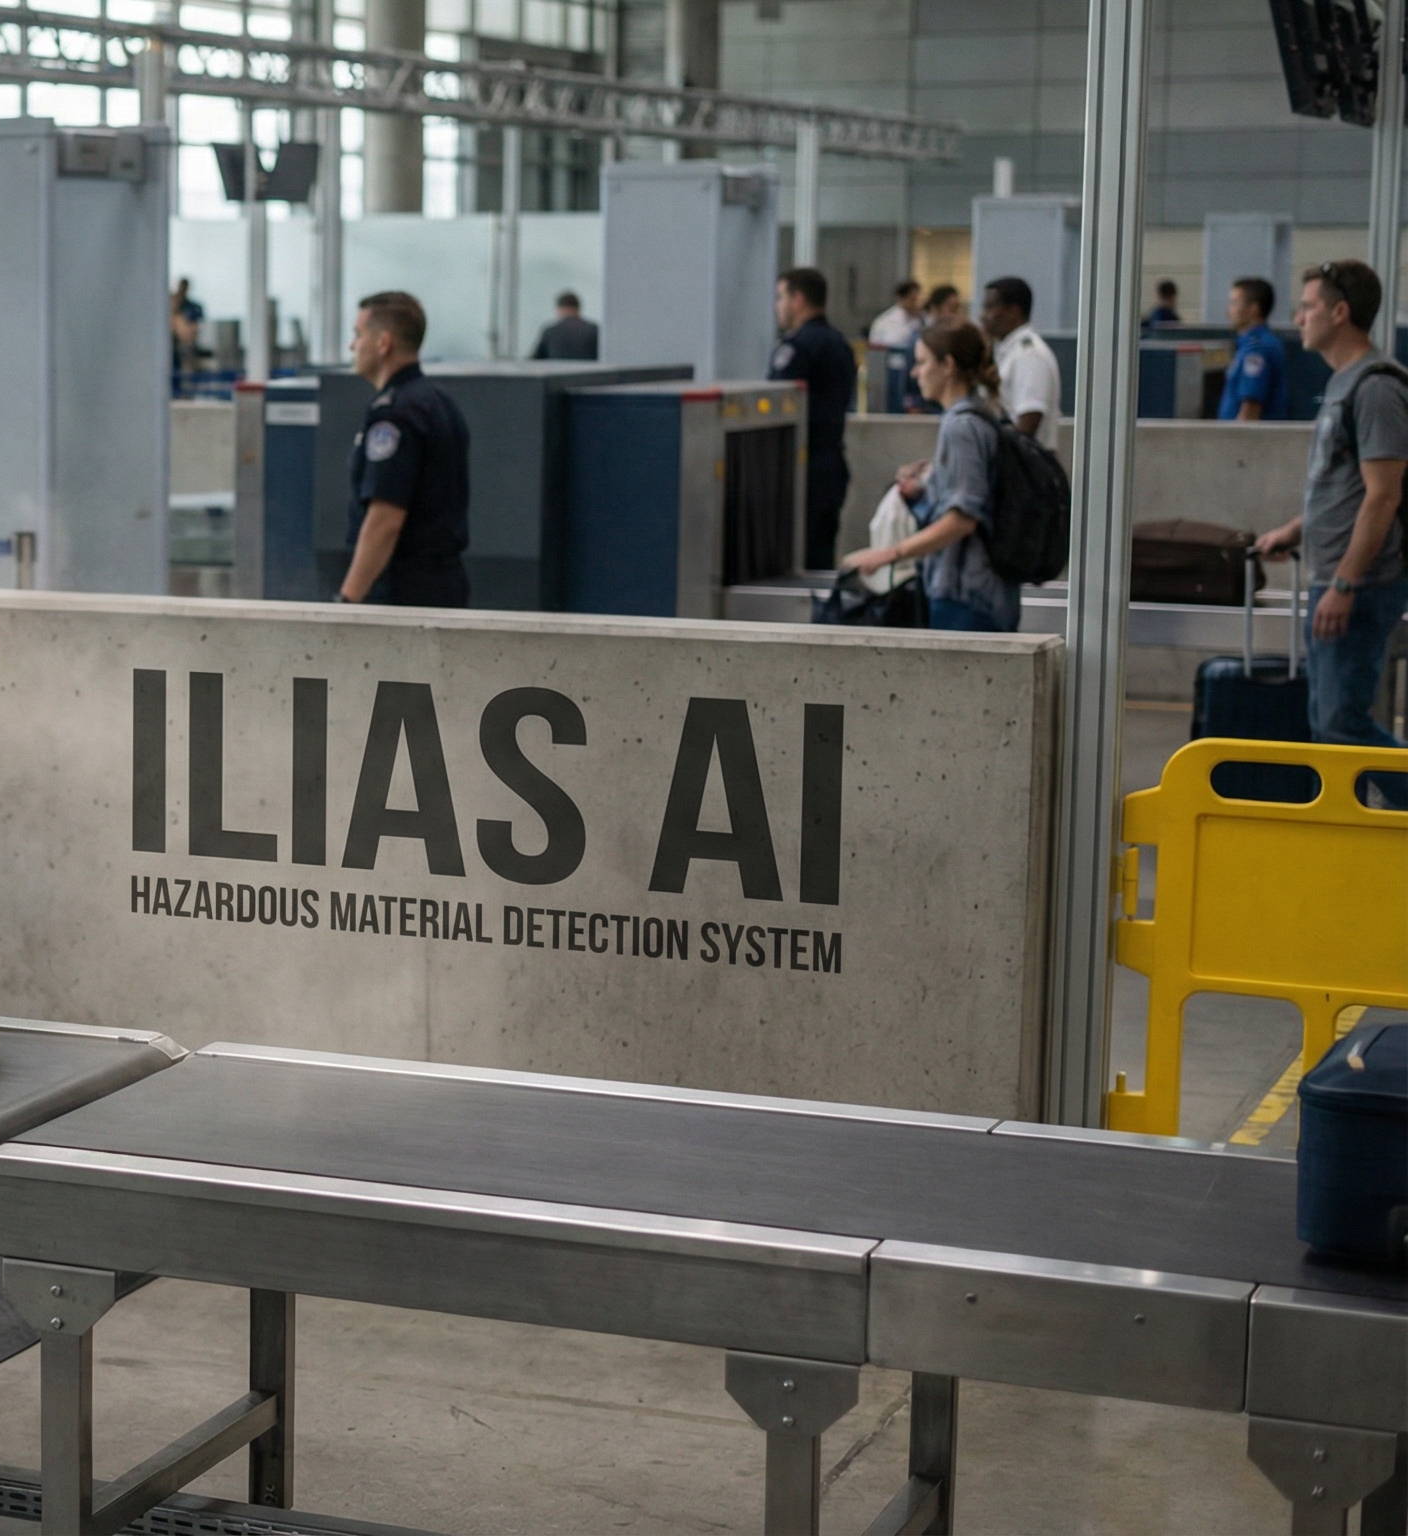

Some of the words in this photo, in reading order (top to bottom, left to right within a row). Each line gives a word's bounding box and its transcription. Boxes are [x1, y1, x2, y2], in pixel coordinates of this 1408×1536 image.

[132, 668, 588, 886] ILIAS
[647, 696, 845, 907] AI
[131, 875, 320, 929] HAZARDOUS
[330, 891, 493, 944] MATERIAL
[503, 905, 689, 961] DETECTION
[699, 921, 843, 975] SYSTEM
